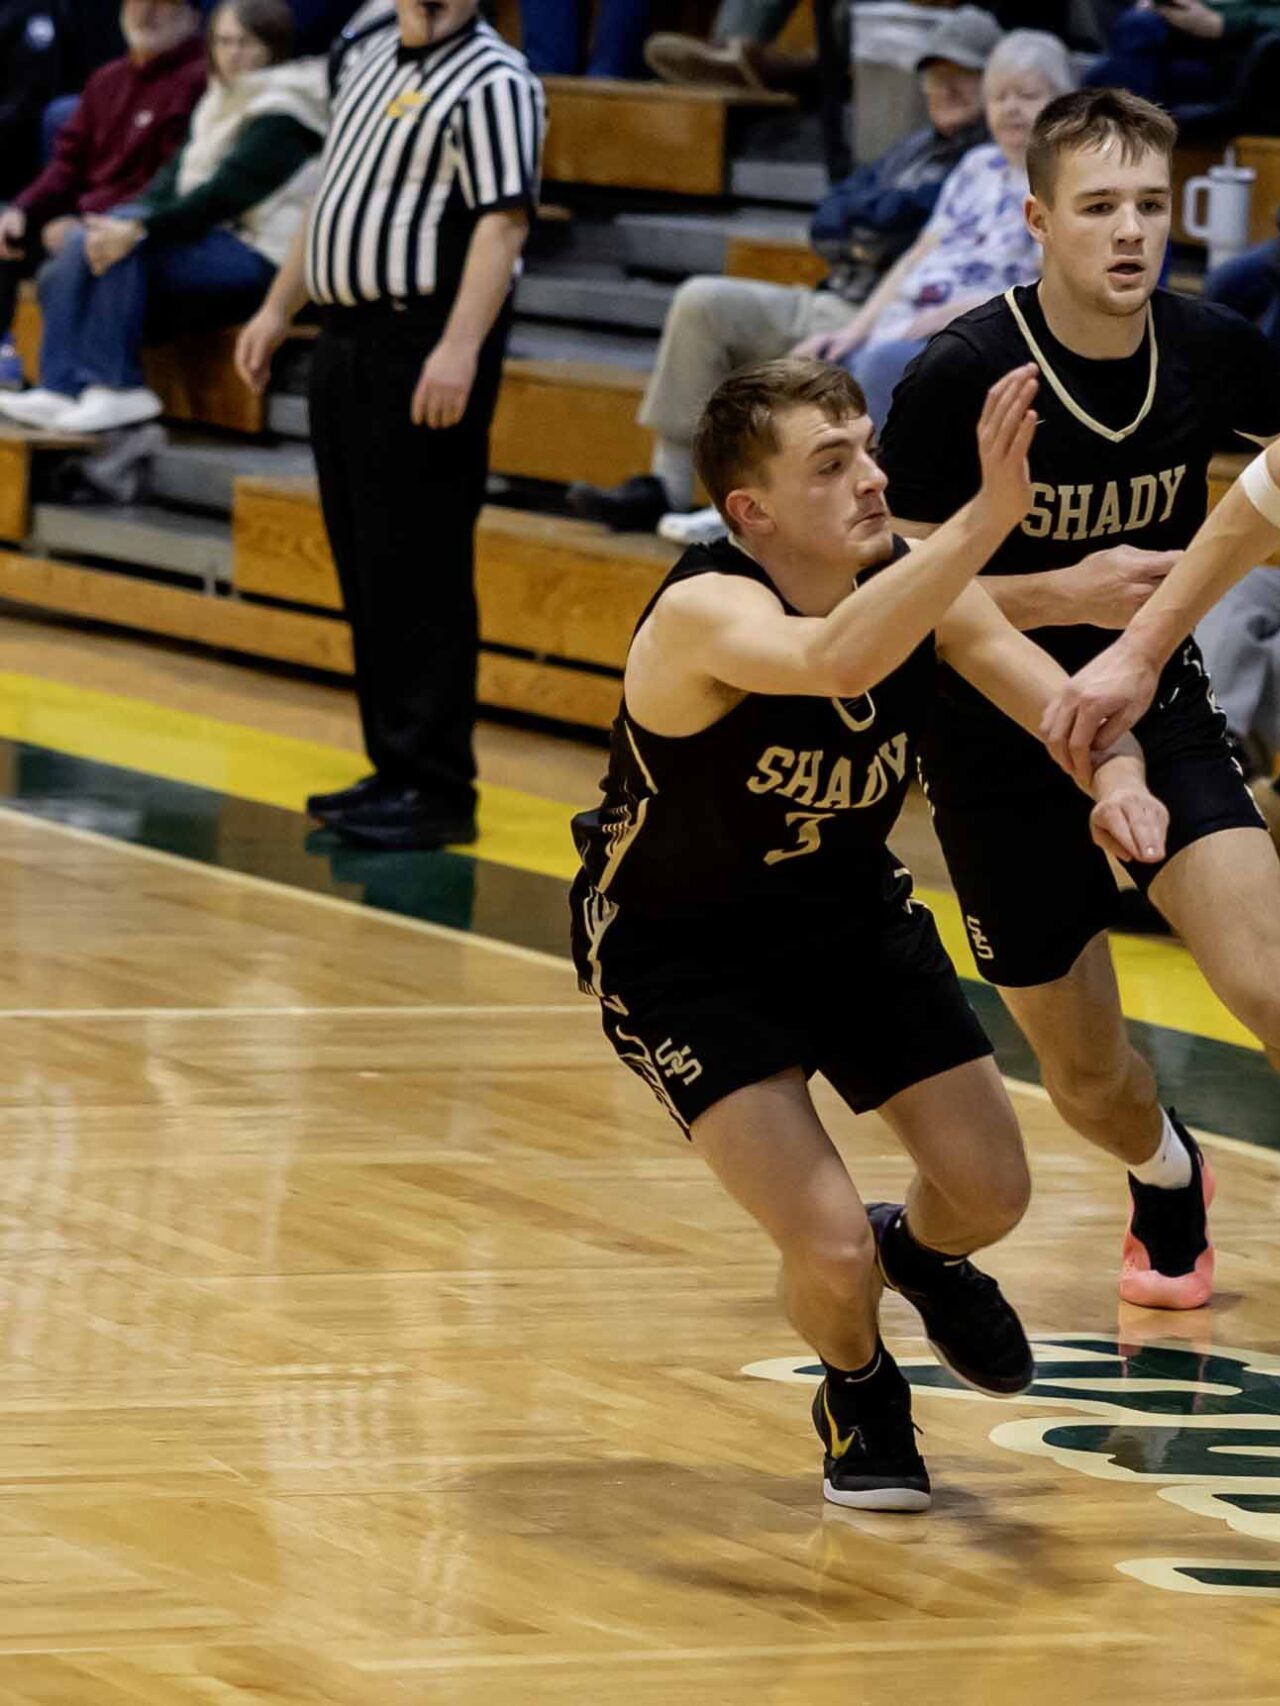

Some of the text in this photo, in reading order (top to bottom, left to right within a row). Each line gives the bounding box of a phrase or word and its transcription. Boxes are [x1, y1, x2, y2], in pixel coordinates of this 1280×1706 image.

[1021, 464, 1187, 541] SHADY
[746, 732, 909, 809] SHADY
[763, 811, 837, 866] 3
